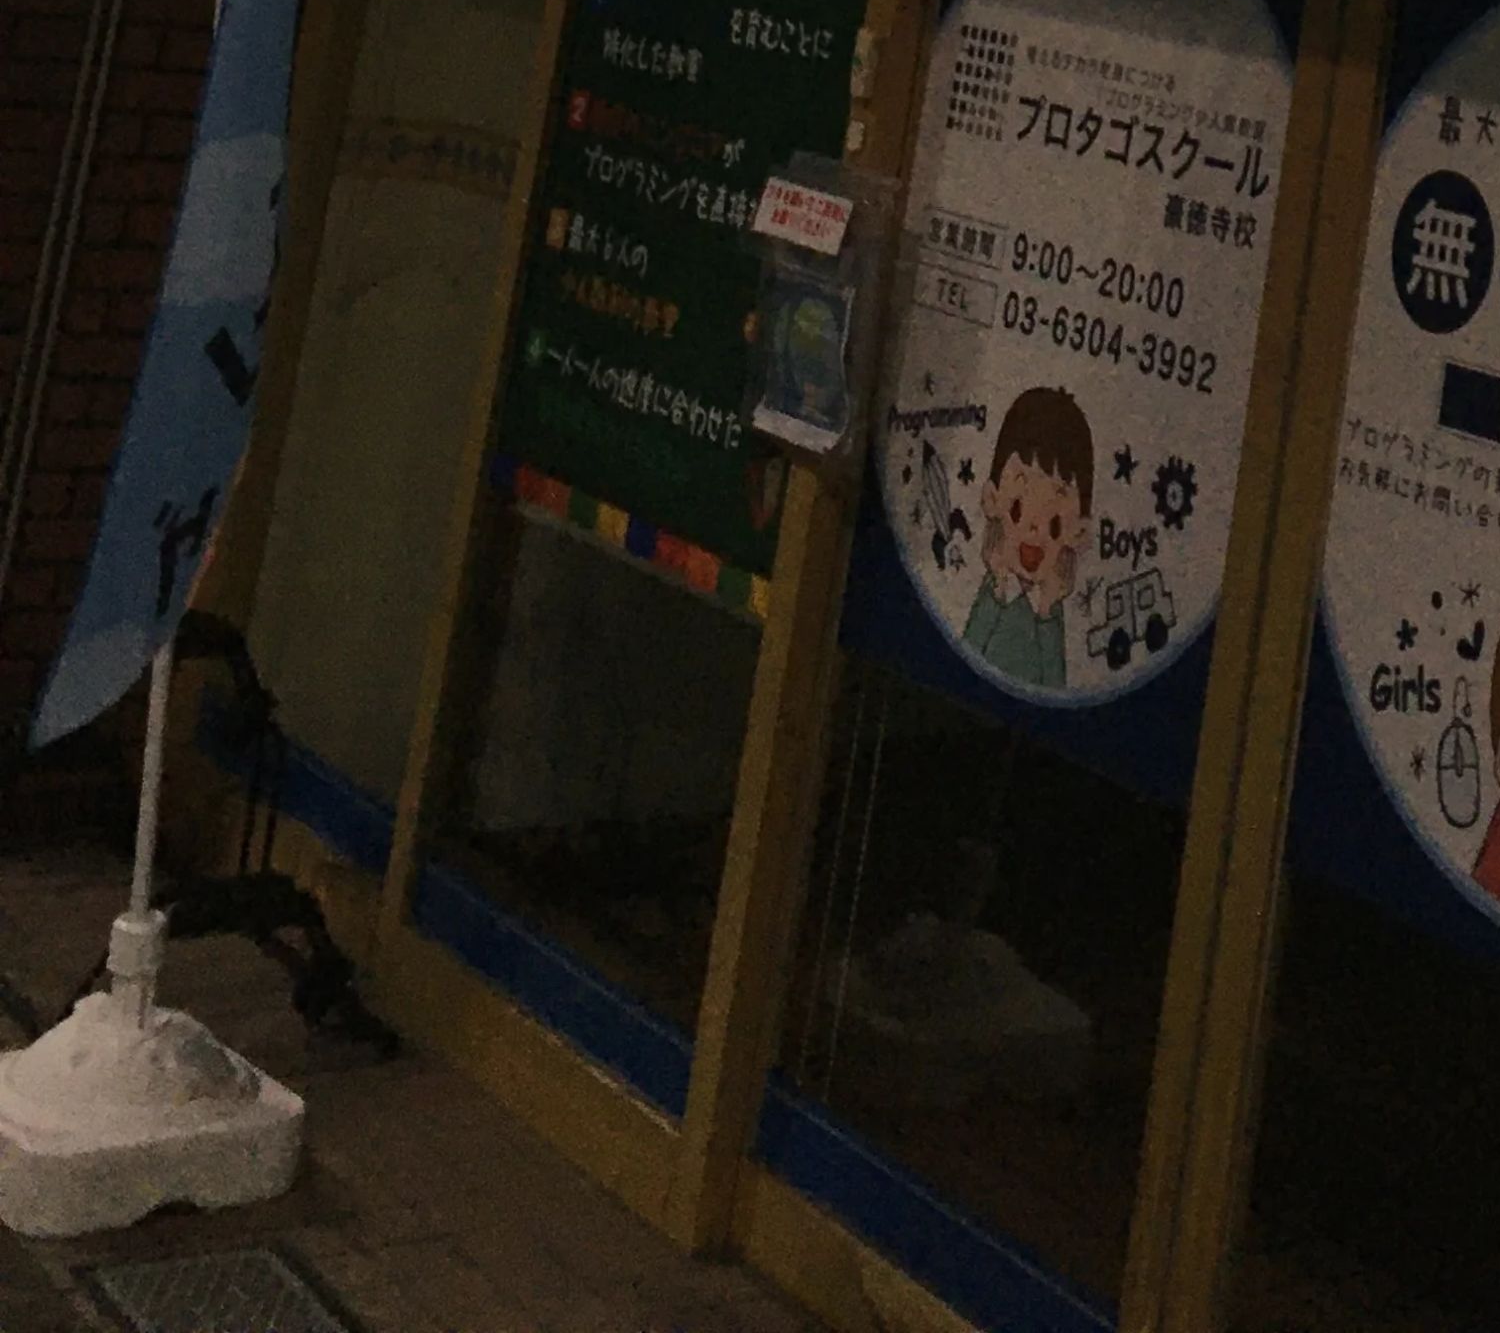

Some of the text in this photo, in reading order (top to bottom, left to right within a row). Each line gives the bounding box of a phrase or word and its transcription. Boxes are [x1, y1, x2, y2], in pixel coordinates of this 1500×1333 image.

[1016, 93, 1270, 199] プロタゴスクール
[937, 277, 971, 310] TEL
[1002, 290, 1218, 394] 03-6304-3992
[1098, 517, 1159, 568] Boys
[1369, 662, 1442, 714] Girls
